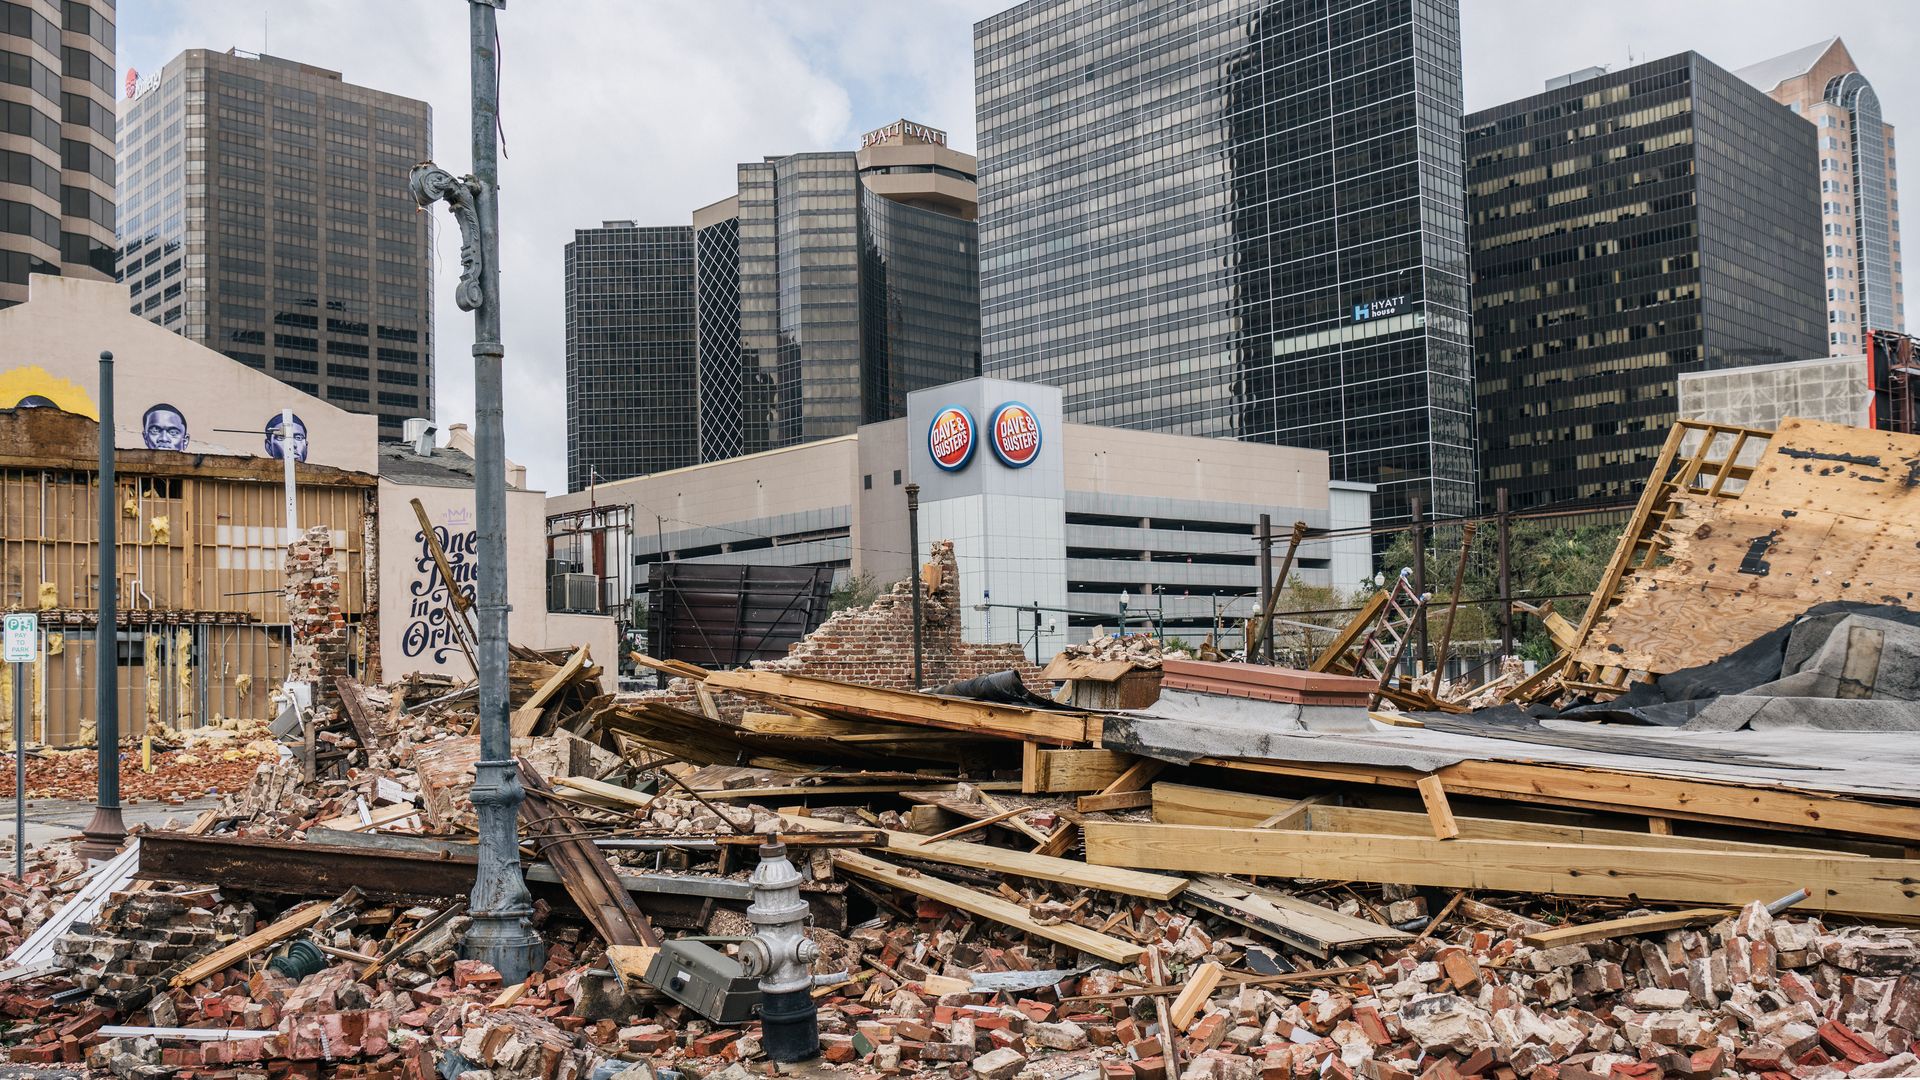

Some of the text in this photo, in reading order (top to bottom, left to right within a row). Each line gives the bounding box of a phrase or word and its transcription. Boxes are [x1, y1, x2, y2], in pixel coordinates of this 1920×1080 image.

[861, 122, 901, 147] HYATT
[904, 122, 947, 145] HYATT
[1371, 296, 1405, 310] HYATT
[1371, 308, 1396, 318] house
[933, 416, 966, 445] DAVE &
[1000, 416, 1036, 438] DAVE &
[934, 430, 968, 458] BUSTER'S
[1002, 430, 1038, 452] BUSTER'S
[410, 598, 429, 618] in
